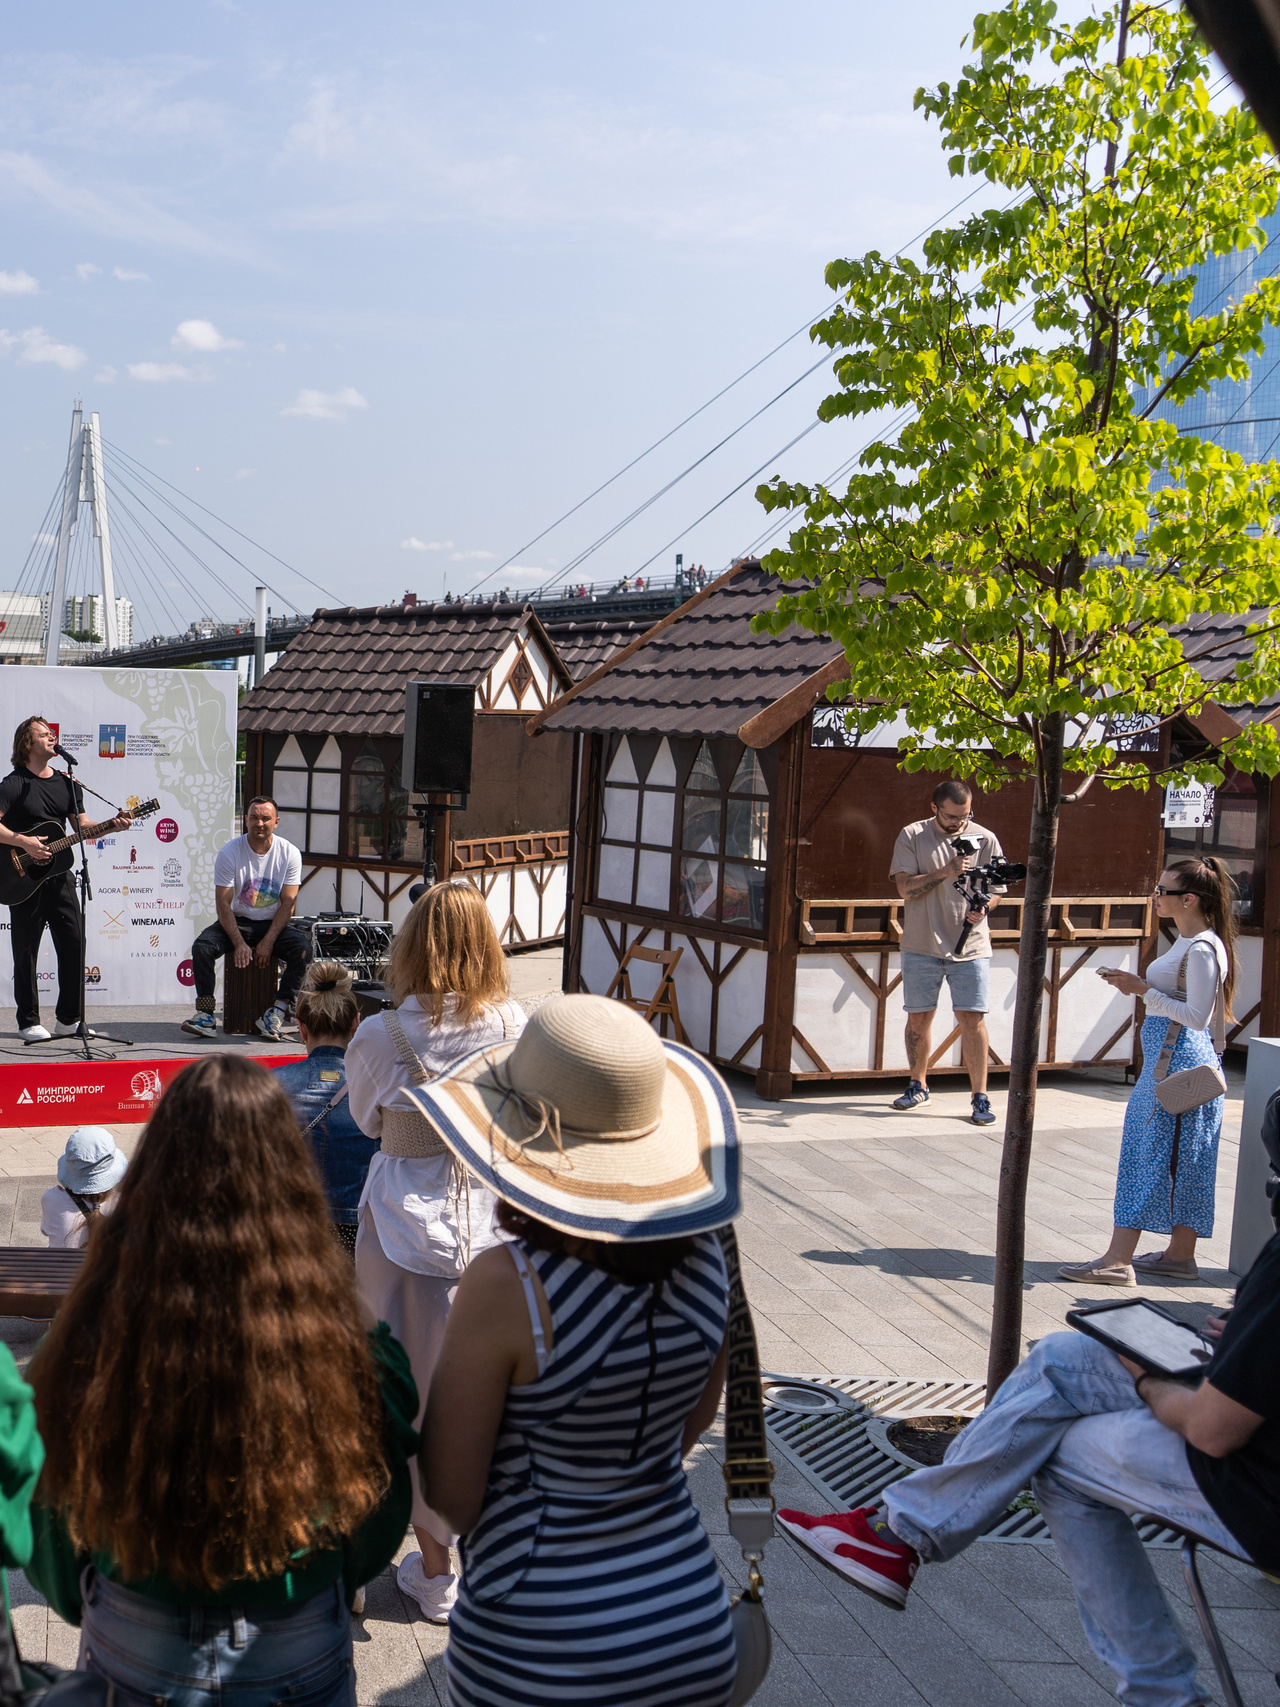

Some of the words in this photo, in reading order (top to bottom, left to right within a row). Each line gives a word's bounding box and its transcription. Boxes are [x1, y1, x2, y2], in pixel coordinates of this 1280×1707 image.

[1169, 790, 1202, 799] НАЧАЛО
[131, 918, 175, 926] WINEMAFIA
[0, 923, 12, 931] по
[37, 1085, 105, 1095] МИНПРОМТОРГ
[37, 1095, 76, 1104] РОССИИ
[117, 1102, 145, 1110] Винная
